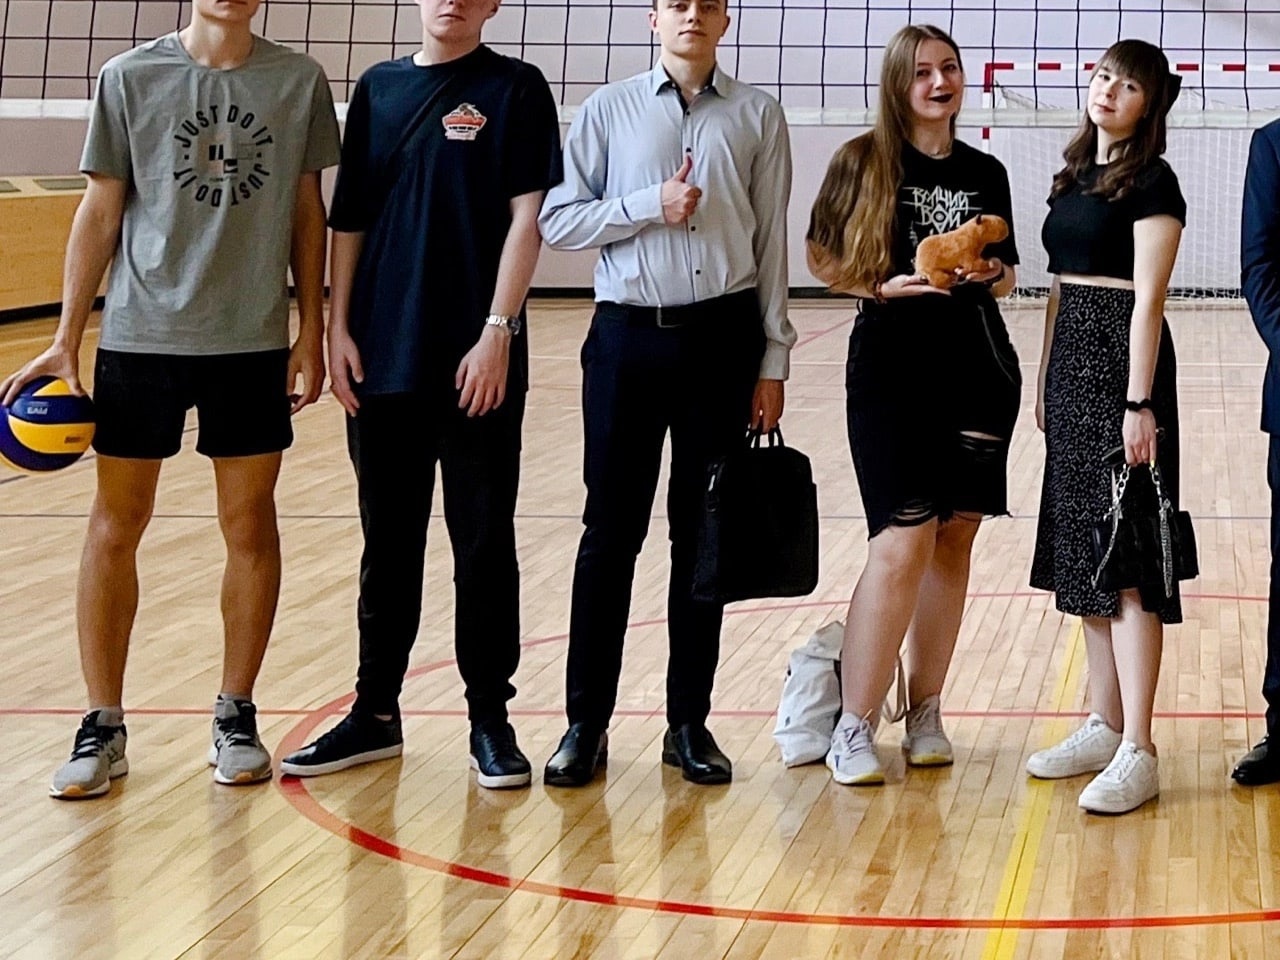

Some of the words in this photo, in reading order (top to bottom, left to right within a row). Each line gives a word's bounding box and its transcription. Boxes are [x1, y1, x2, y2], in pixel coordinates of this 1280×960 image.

[174, 104, 218, 148] JUST
[227, 104, 255, 129] DO
[252, 126, 273, 146] IT
[173, 167, 198, 190] IT
[230, 163, 270, 207] JUST
[195, 184, 223, 208] DO
